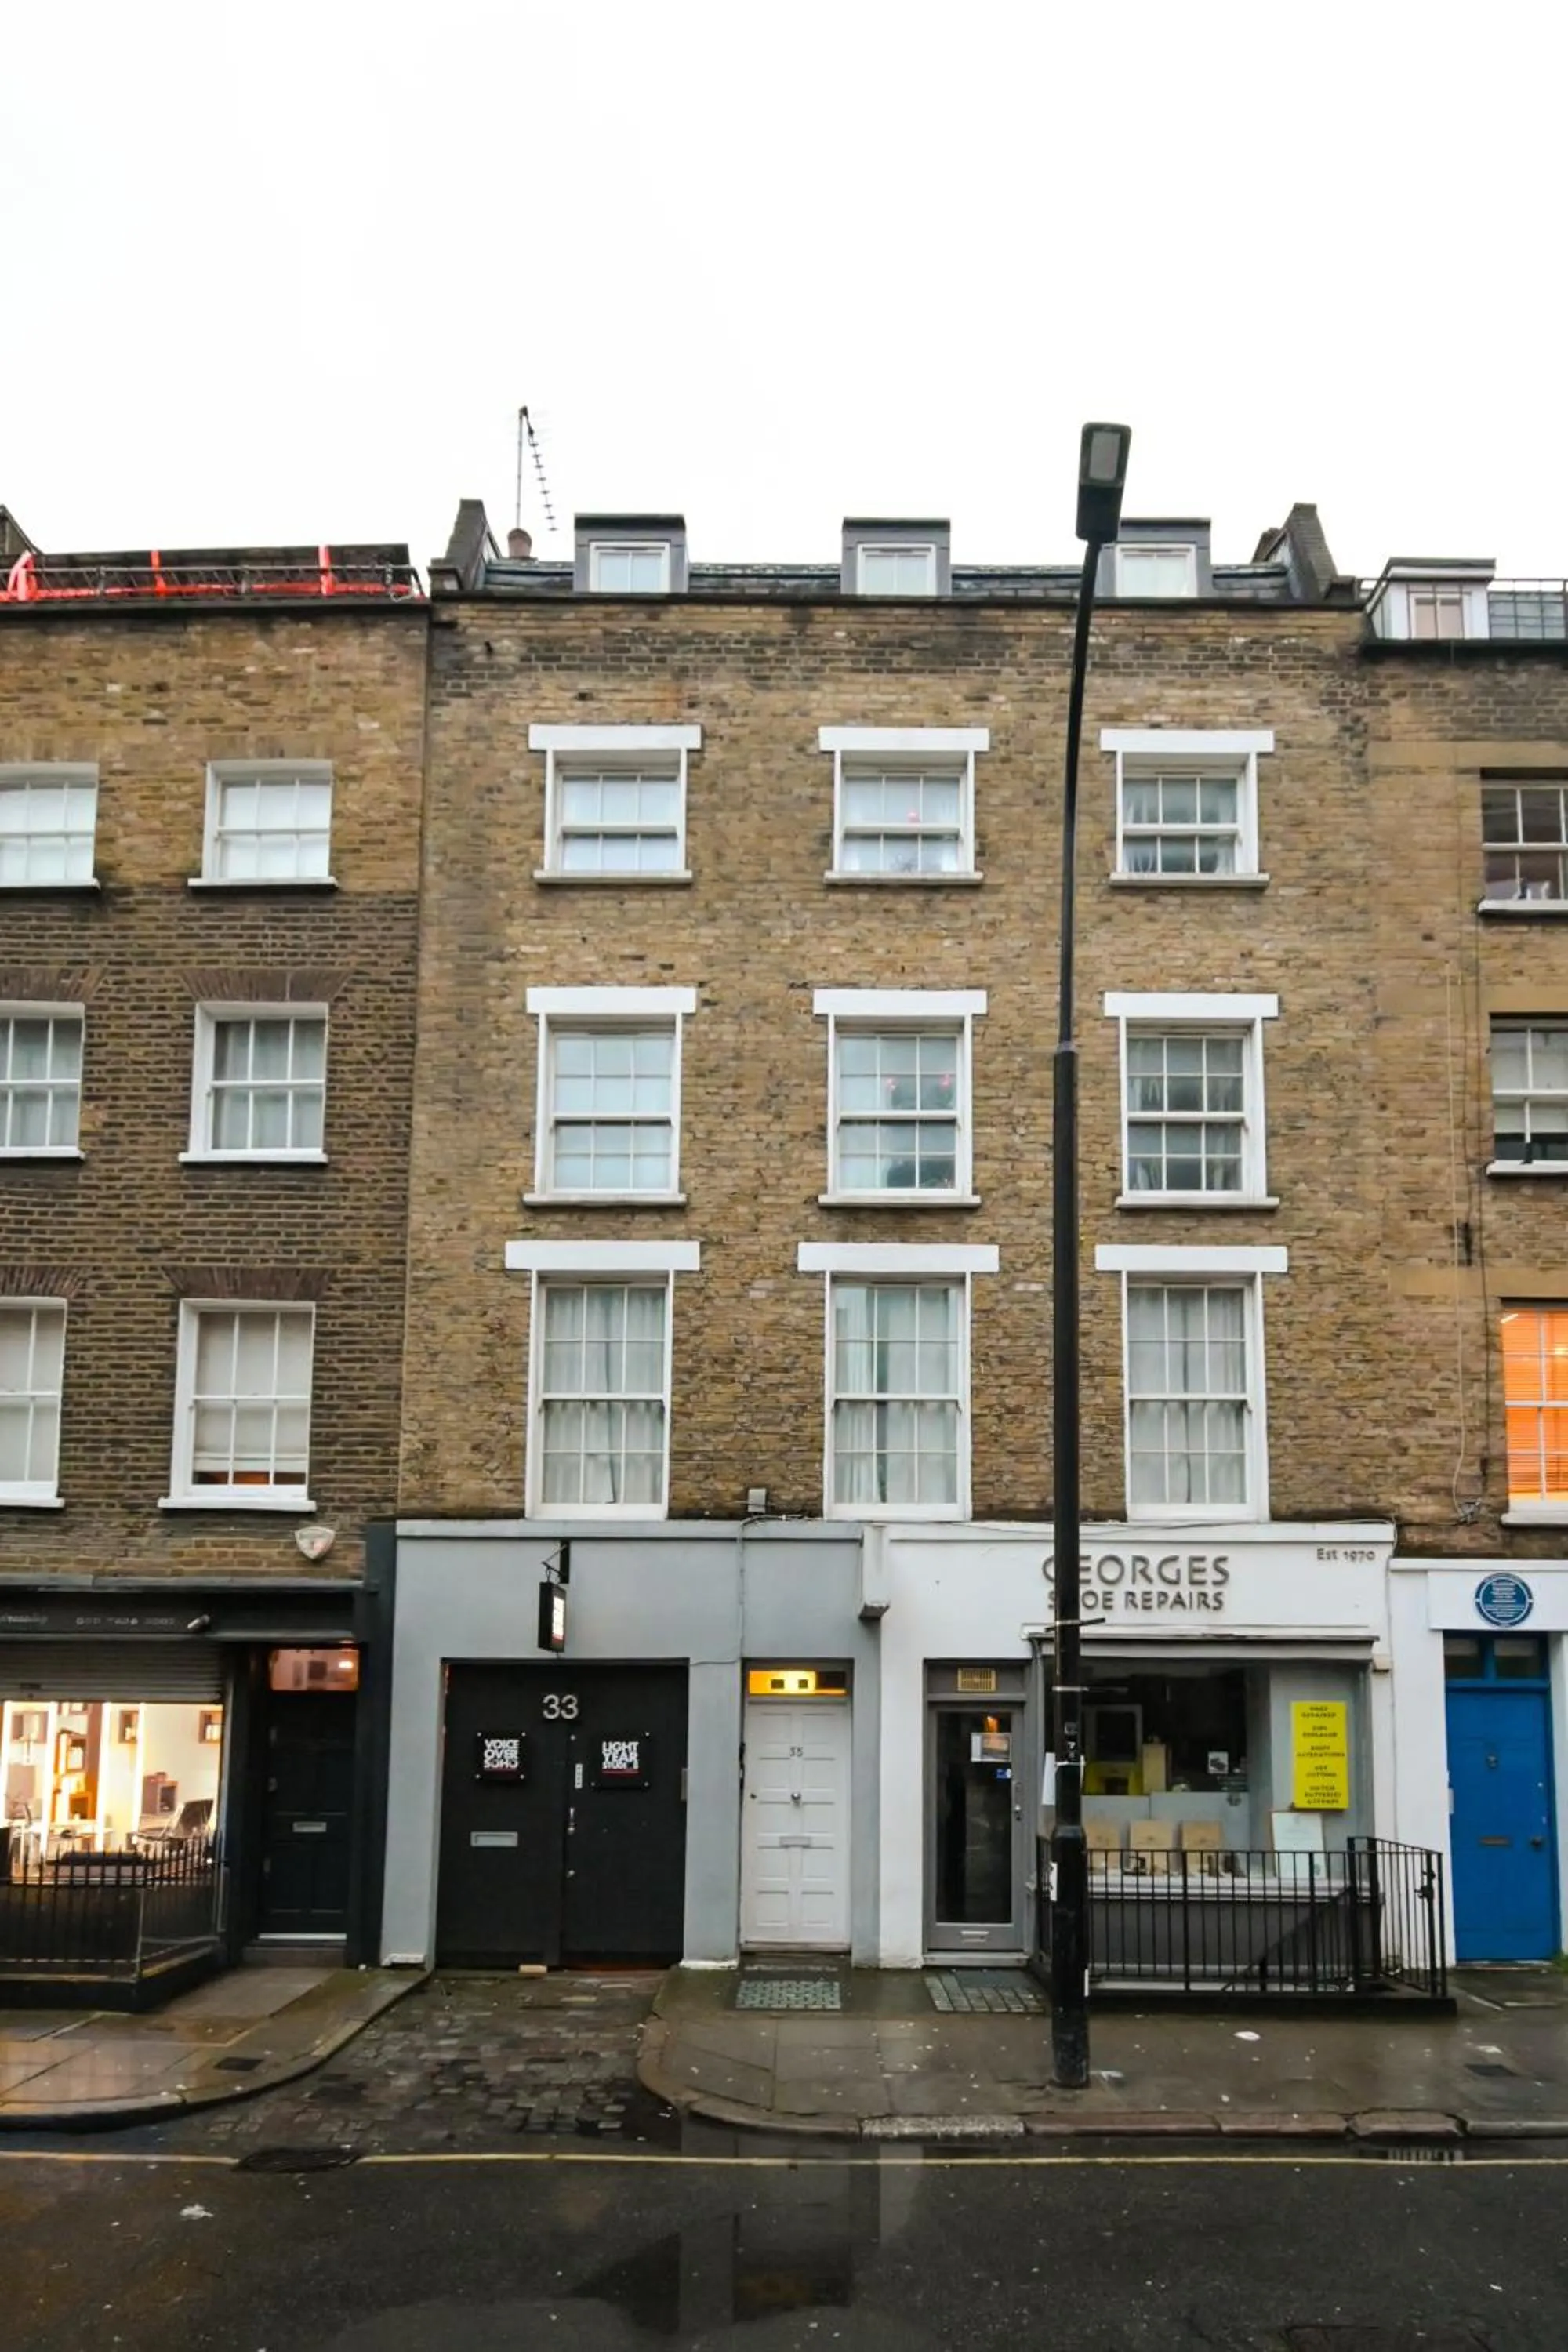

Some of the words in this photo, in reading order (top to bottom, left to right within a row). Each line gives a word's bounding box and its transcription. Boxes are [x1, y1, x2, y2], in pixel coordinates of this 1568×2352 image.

[1316, 1548, 1338, 1561] Est
[1343, 1550, 1375, 1563] 1970
[1047, 1589, 1113, 1610] SOE
[1124, 1590, 1224, 1611] REPAIRS
[543, 1694, 578, 1719] 33
[484, 1738, 520, 1749] VOICE
[602, 1741, 639, 1751] LIGHT
[484, 1749, 519, 1760] OVER
[602, 1751, 639, 1762] YEAR
[483, 1759, 519, 1769] SOHO
